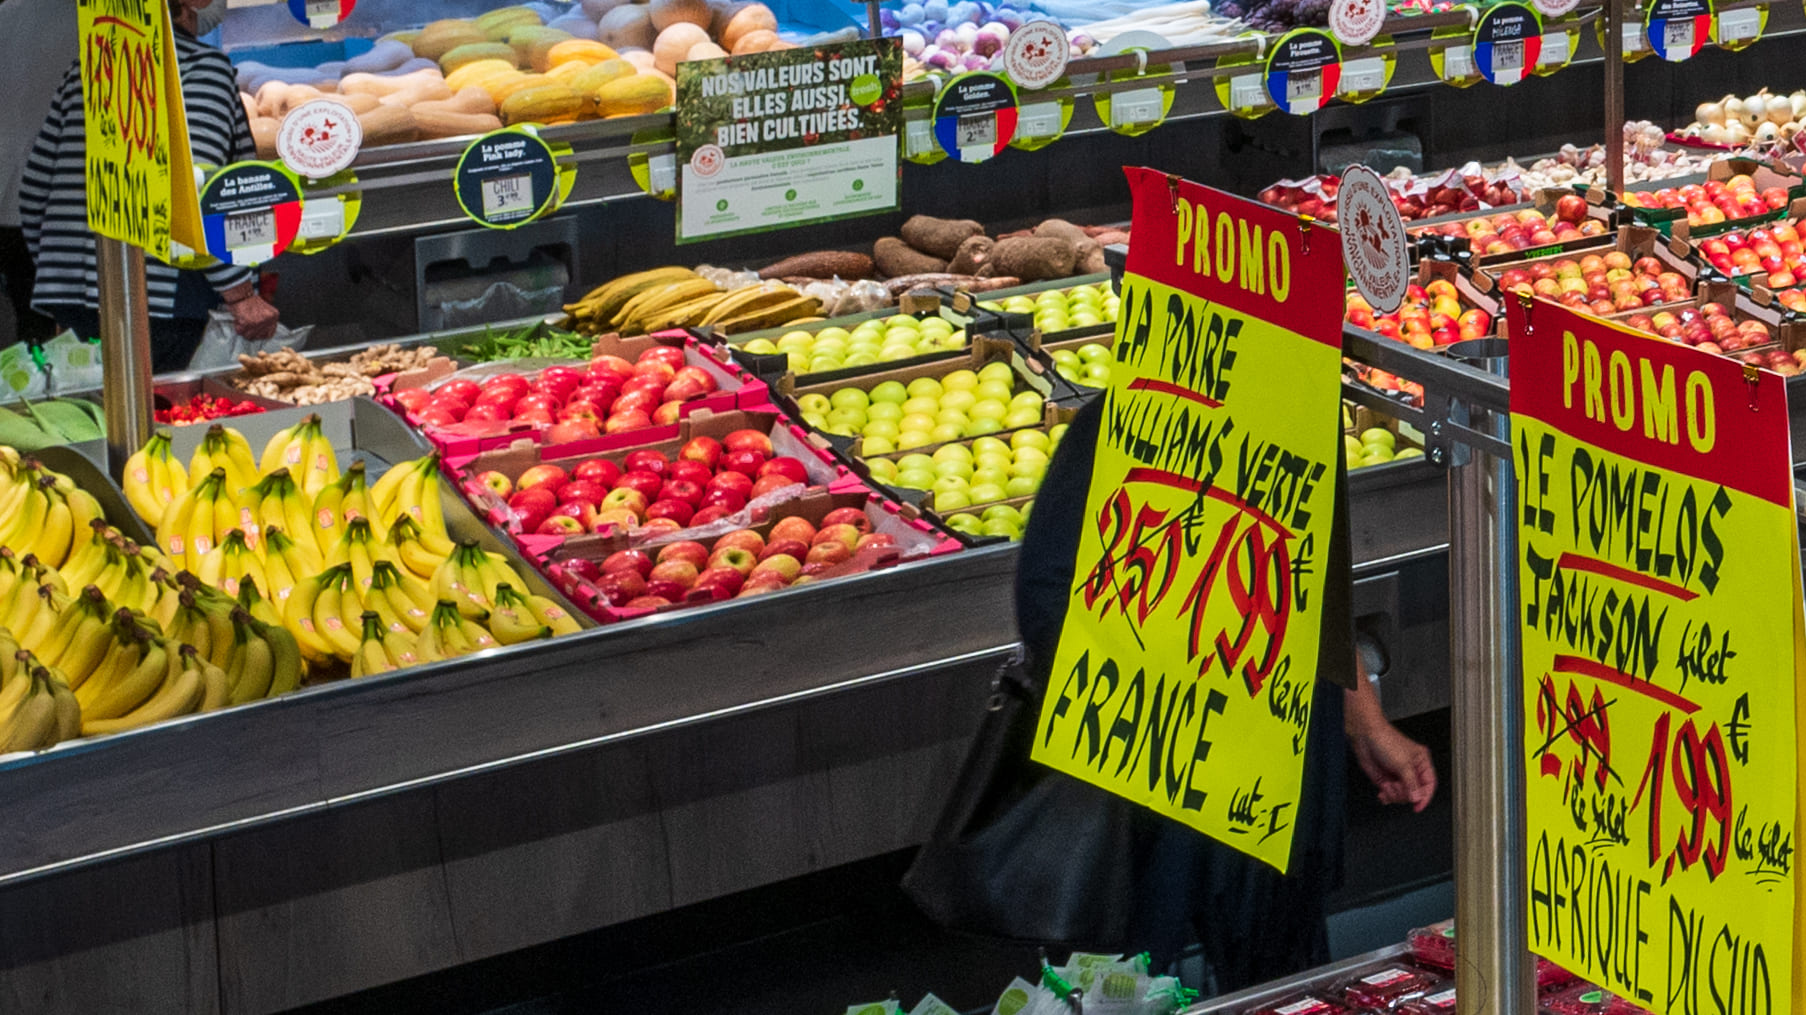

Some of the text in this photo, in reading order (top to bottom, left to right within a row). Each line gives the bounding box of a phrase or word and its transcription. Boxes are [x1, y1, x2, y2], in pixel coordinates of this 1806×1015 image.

[702, 55, 881, 98] NOS VALEURS SONT,
[1299, 40, 1323, 51] pomme
[732, 93, 786, 120] ELLES
[958, 82, 996, 94] La pomme
[481, 140, 526, 153] La pomme
[483, 151, 501, 162] Pink
[717, 104, 865, 147] BIEN CULTIVÉES.
[219, 182, 276, 197] des Antilles.
[224, 174, 271, 187] La banane
[1176, 197, 1291, 304] PROMO
[1116, 284, 1244, 404] LA POIRE
[1563, 330, 1716, 454] PROMO
[1106, 385, 1327, 531] WILLIAMS VERTE
[1521, 427, 1733, 596] LE POMELOS
[1526, 540, 1737, 695] JACKSON filet
[1045, 649, 1227, 812] FRANCE
[1570, 784, 1794, 878] le filet le filet
[1531, 829, 1772, 1015] AFRIQUE DU SUD
